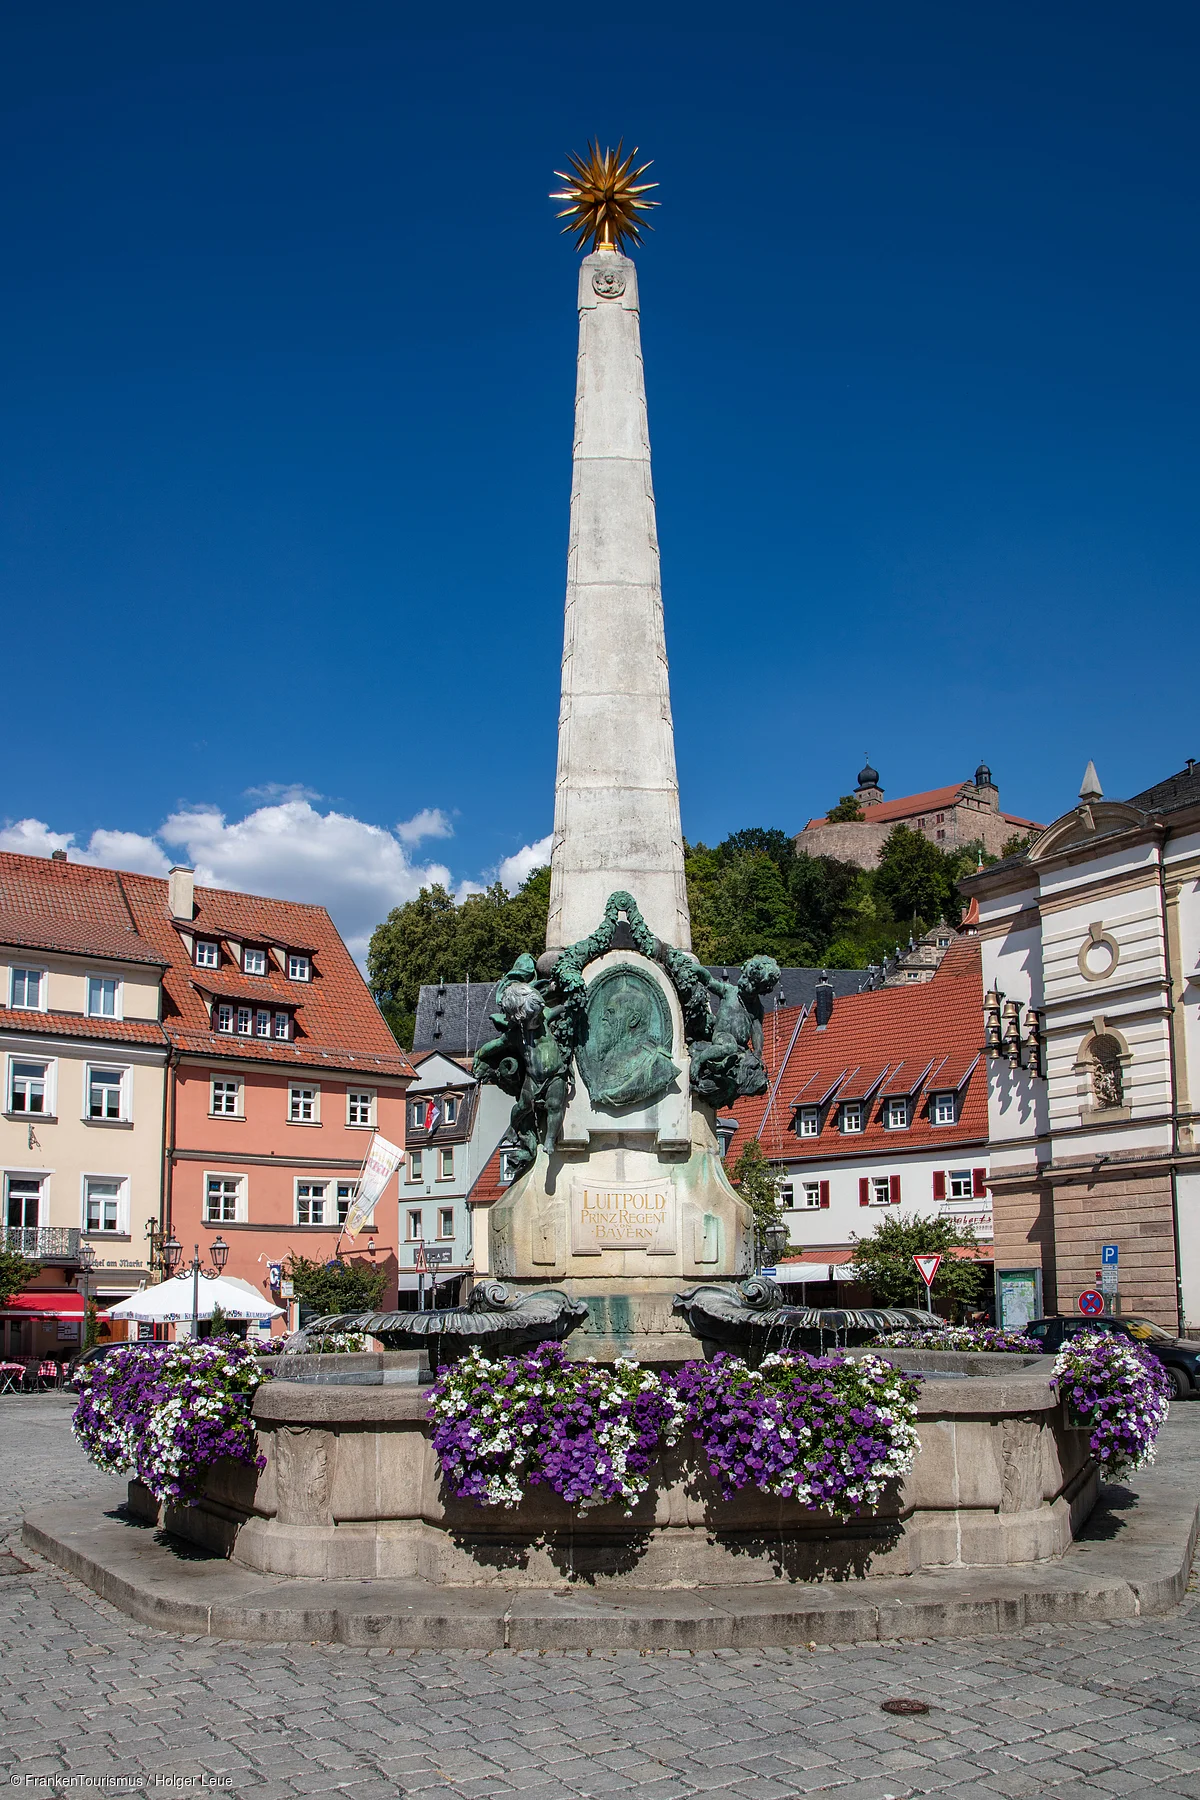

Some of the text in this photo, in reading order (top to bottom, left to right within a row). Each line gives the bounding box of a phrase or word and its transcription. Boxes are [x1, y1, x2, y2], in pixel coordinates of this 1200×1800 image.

[583, 1190, 665, 1210] LUITPOLD
[581, 1209, 667, 1224] PRINZ REGENT
[595, 1225, 653, 1241] BAYERN
[1105, 1247, 1115, 1262] P
[119, 1258, 143, 1268] Markt
